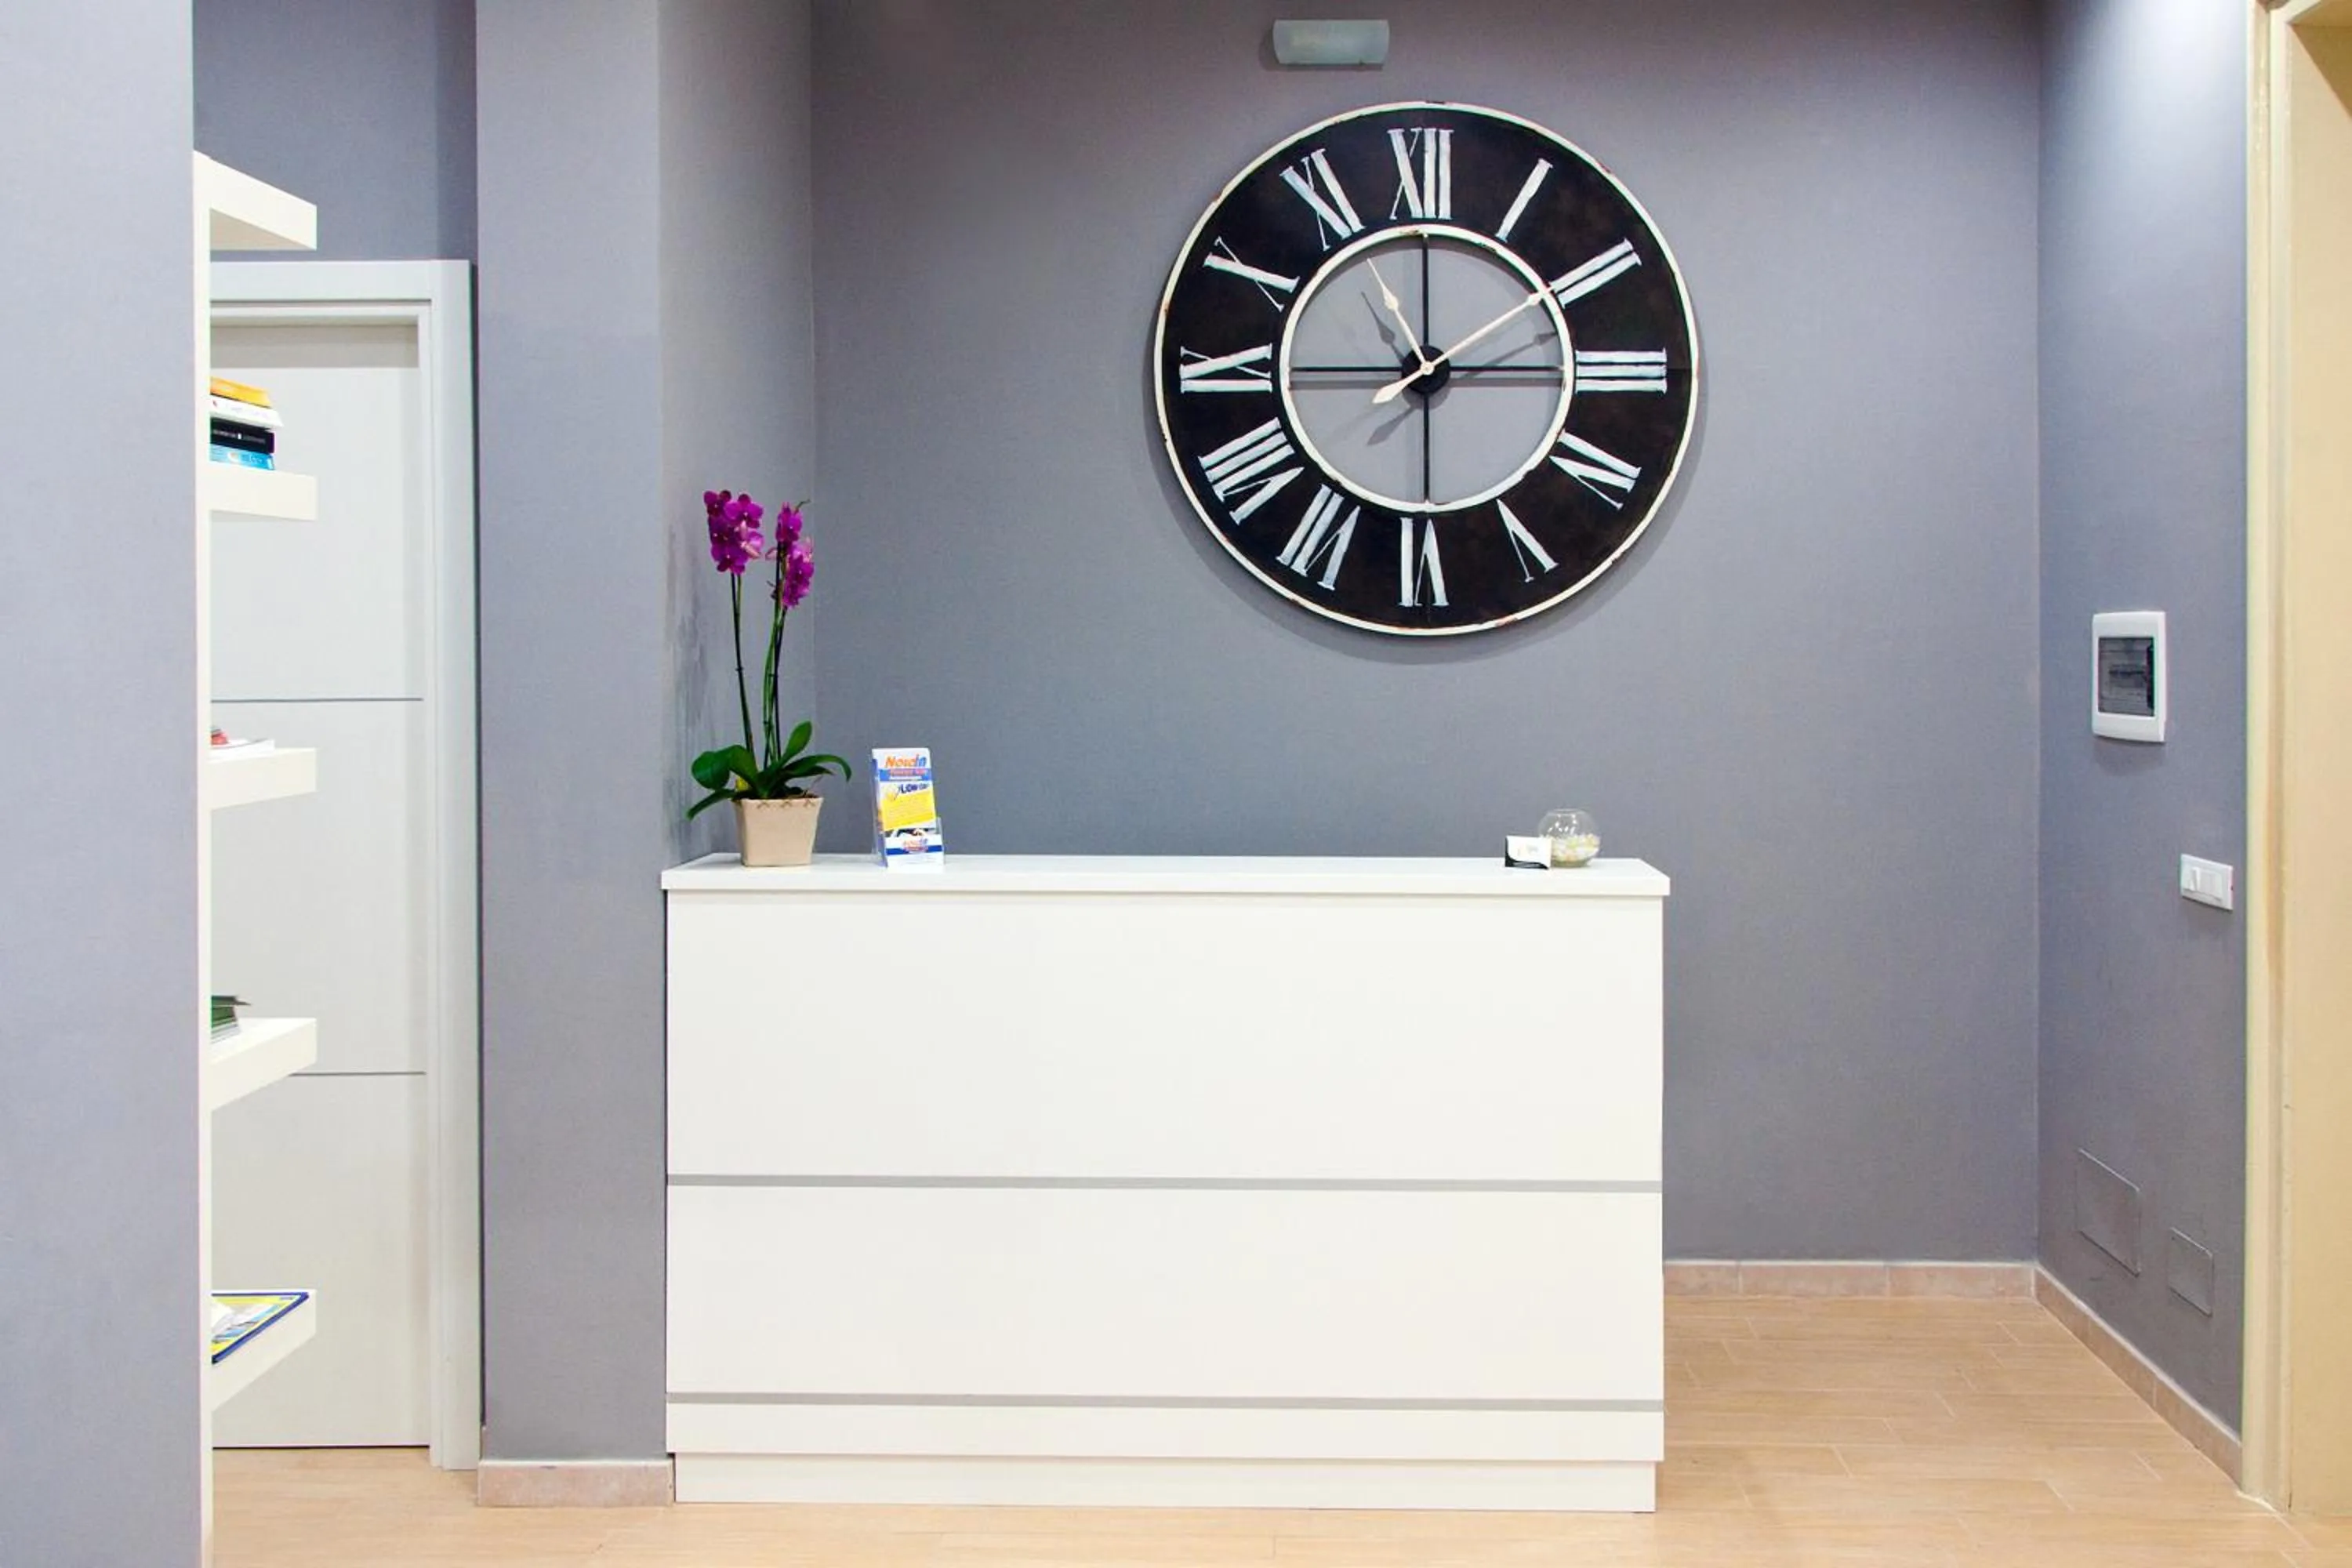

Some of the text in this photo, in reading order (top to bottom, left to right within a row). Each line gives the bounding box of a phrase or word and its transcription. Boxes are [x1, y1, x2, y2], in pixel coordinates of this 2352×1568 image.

[1279, 148, 1365, 251] XI
[1388, 127, 1454, 220] XII
[1495, 158, 1552, 242] I
[1204, 237, 1299, 312] X
[1549, 238, 1642, 309] II
[1179, 343, 1272, 393] IX
[1575, 348, 1667, 394] III
[1198, 417, 1304, 524] VIII
[1549, 429, 1641, 509] IV
[1276, 485, 1360, 590] VII
[1399, 517, 1449, 607] VI
[1497, 499, 1558, 582] V
